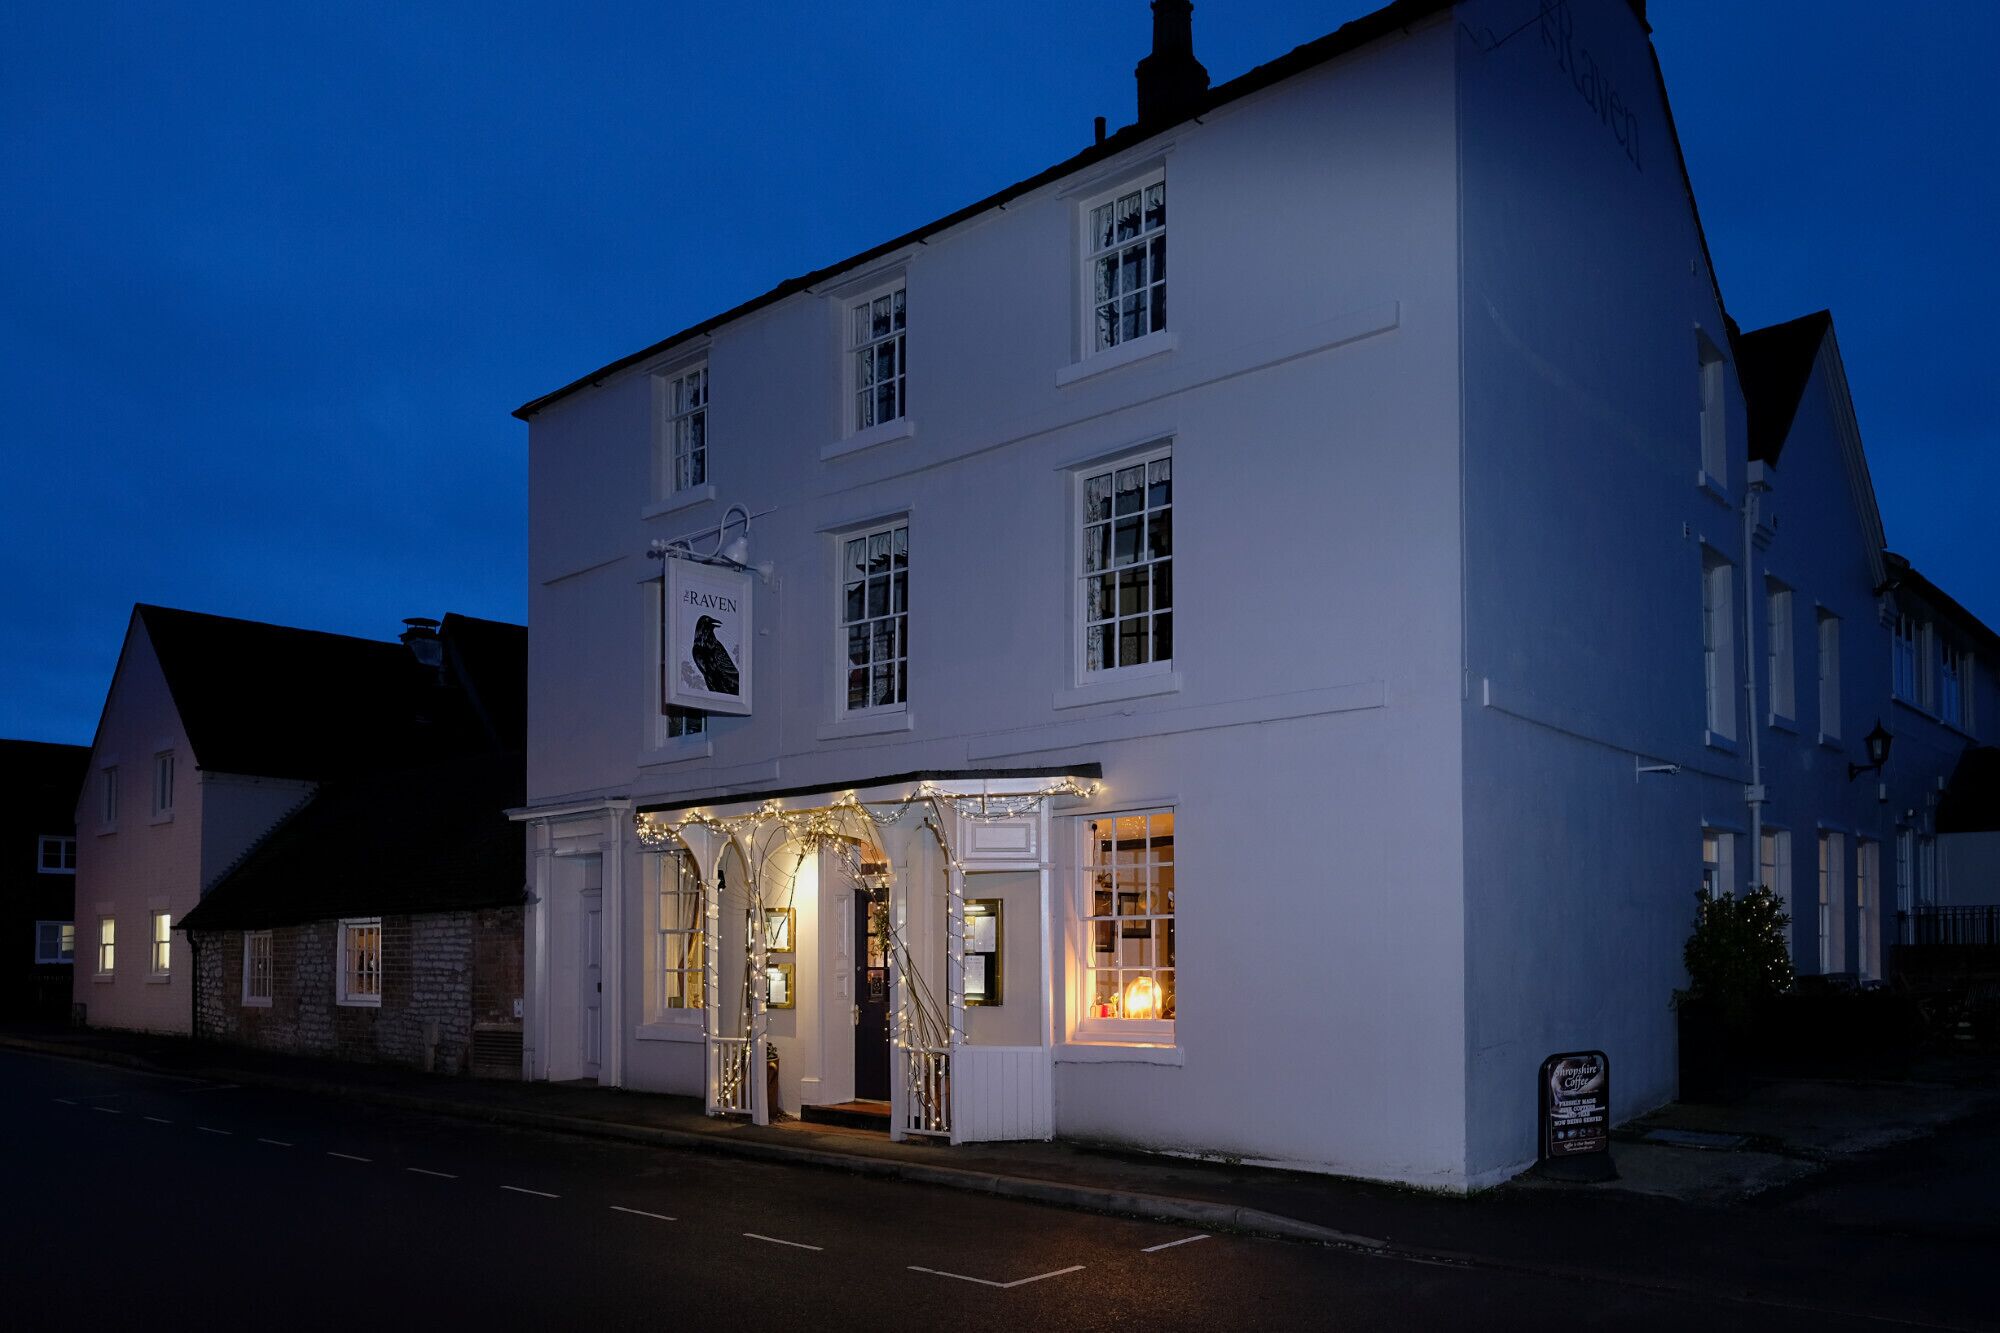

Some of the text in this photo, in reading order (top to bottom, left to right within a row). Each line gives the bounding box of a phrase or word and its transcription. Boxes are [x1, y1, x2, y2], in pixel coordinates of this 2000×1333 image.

[690, 591, 737, 613] RAVEN
[1555, 1064, 1597, 1078] Shropshire
[1565, 1074, 1589, 1091] Coffee
